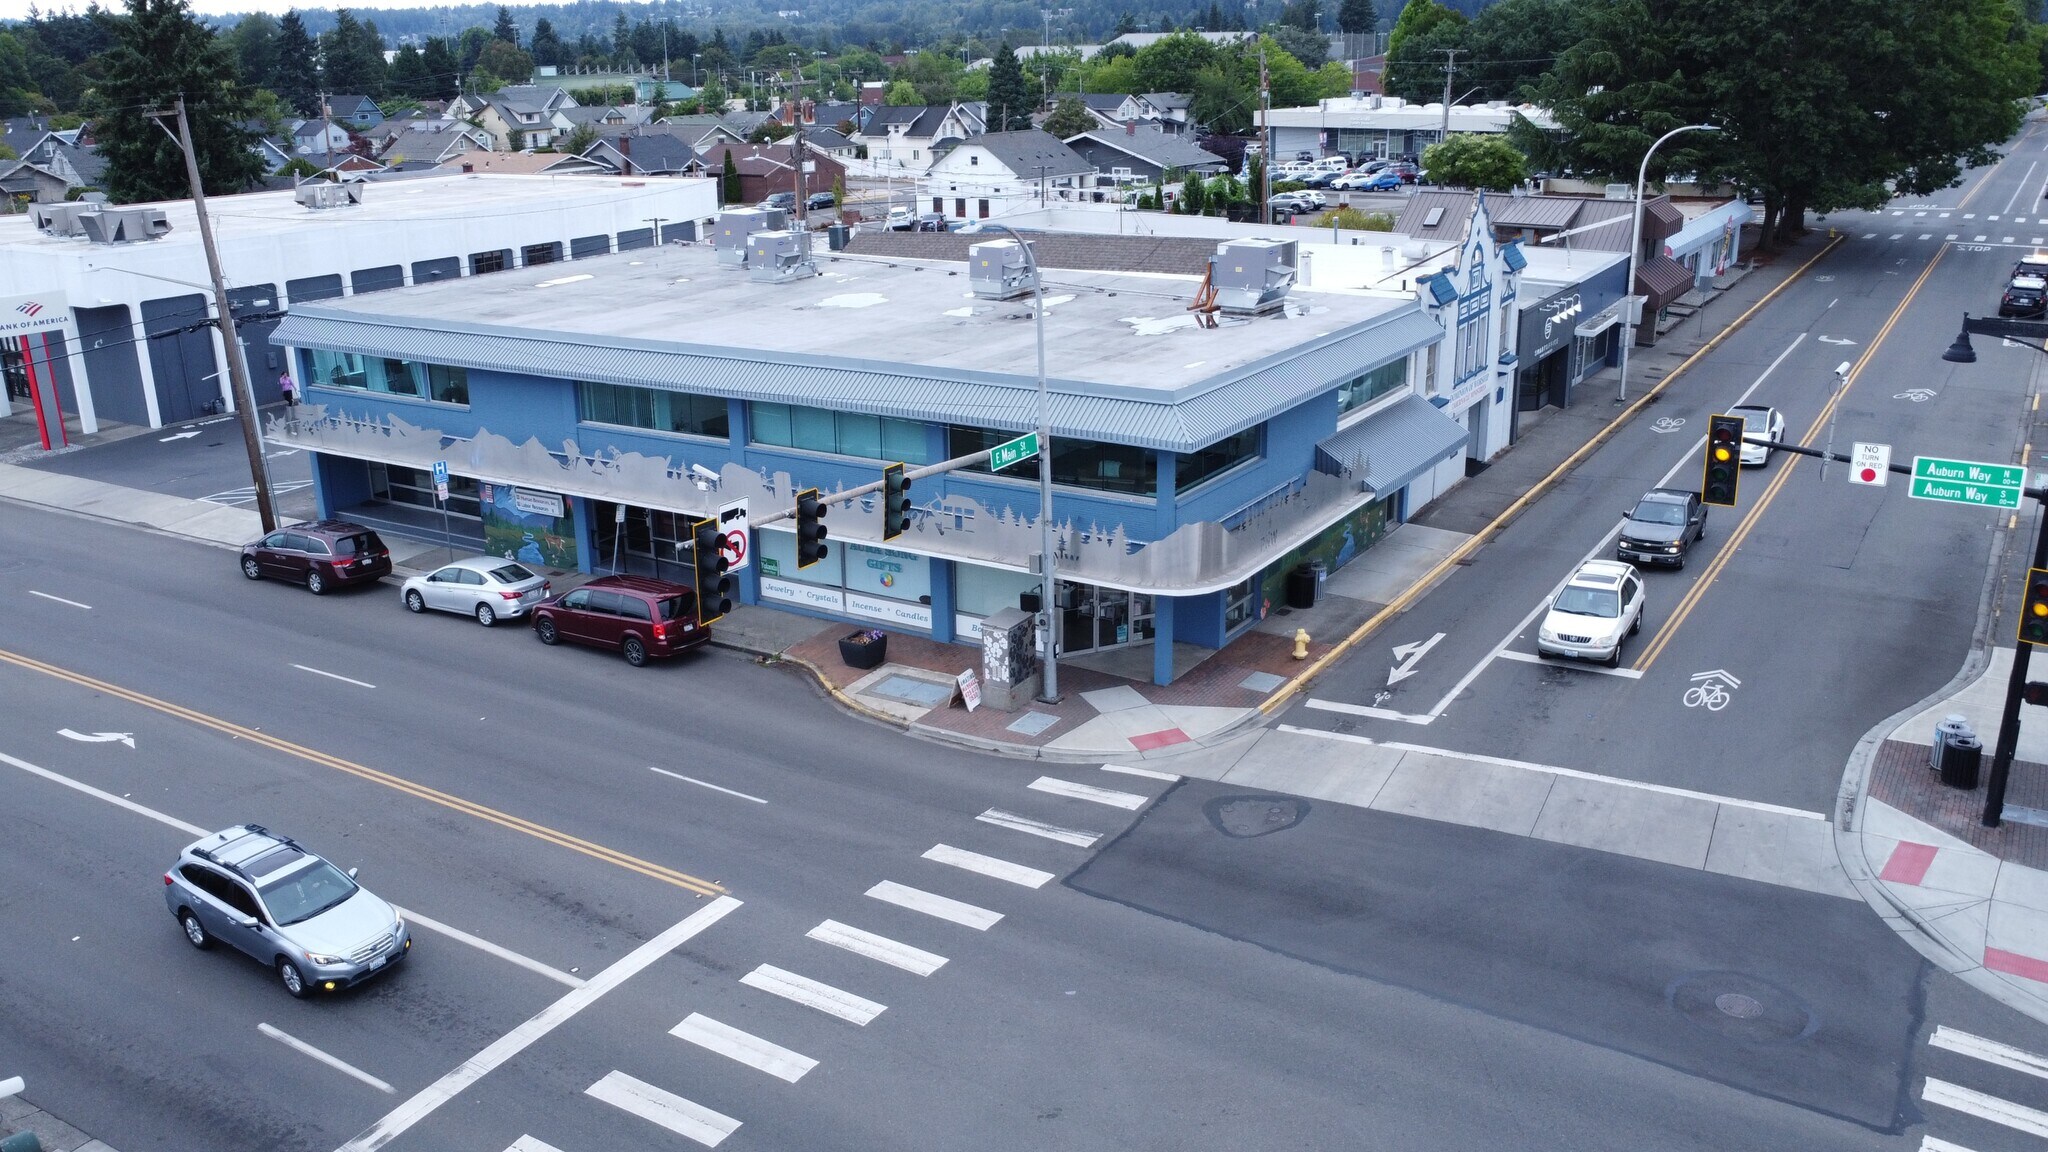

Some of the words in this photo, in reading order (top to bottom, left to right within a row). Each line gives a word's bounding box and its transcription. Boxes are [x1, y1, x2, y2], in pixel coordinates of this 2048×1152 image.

[33, 316, 69, 327] AMERICA
[995, 452, 1001, 464] E
[1001, 447, 1017, 463] Main
[1020, 441, 1026, 451] St
[1864, 445, 1879, 453] NO
[436, 462, 446, 474] H
[1926, 462, 1964, 479] Auburn
[1969, 467, 1991, 483] Way
[2003, 470, 2010, 478] N
[1923, 482, 1961, 499] Auburn
[1965, 487, 1988, 503] Way
[2000, 490, 2006, 498] S
[867, 558, 902, 573] GIFTS
[766, 583, 795, 596] Jewelry
[807, 591, 838, 603] Crystals
[852, 601, 882, 613] Incense
[895, 609, 928, 622] Candles
